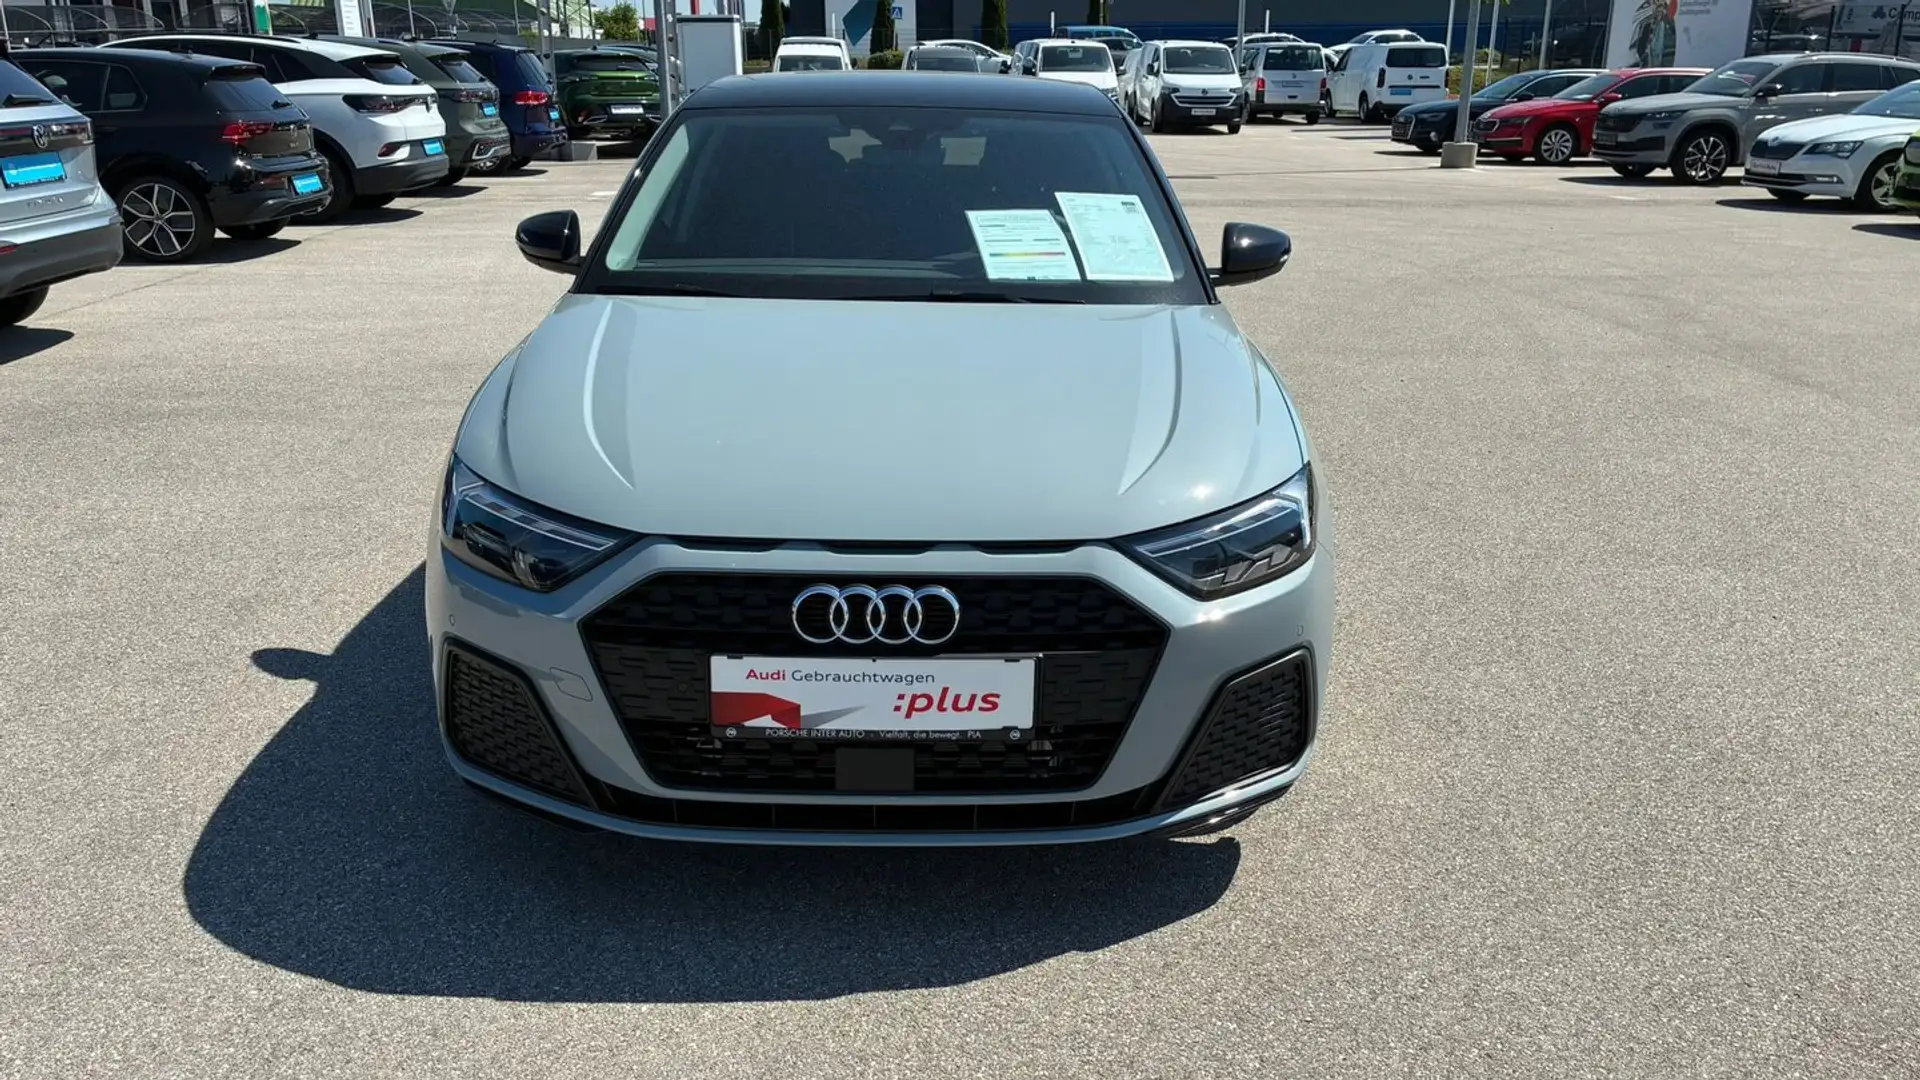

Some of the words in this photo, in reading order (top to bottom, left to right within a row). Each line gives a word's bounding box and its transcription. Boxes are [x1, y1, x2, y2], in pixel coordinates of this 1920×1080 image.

[745, 669, 786, 681] Audi
[791, 669, 936, 686] Gebrauchtwagen
[765, 728, 808, 738] PORSCHE
[811, 728, 836, 738] INTER
[838, 729, 866, 738] AUTO
[913, 730, 927, 739] die
